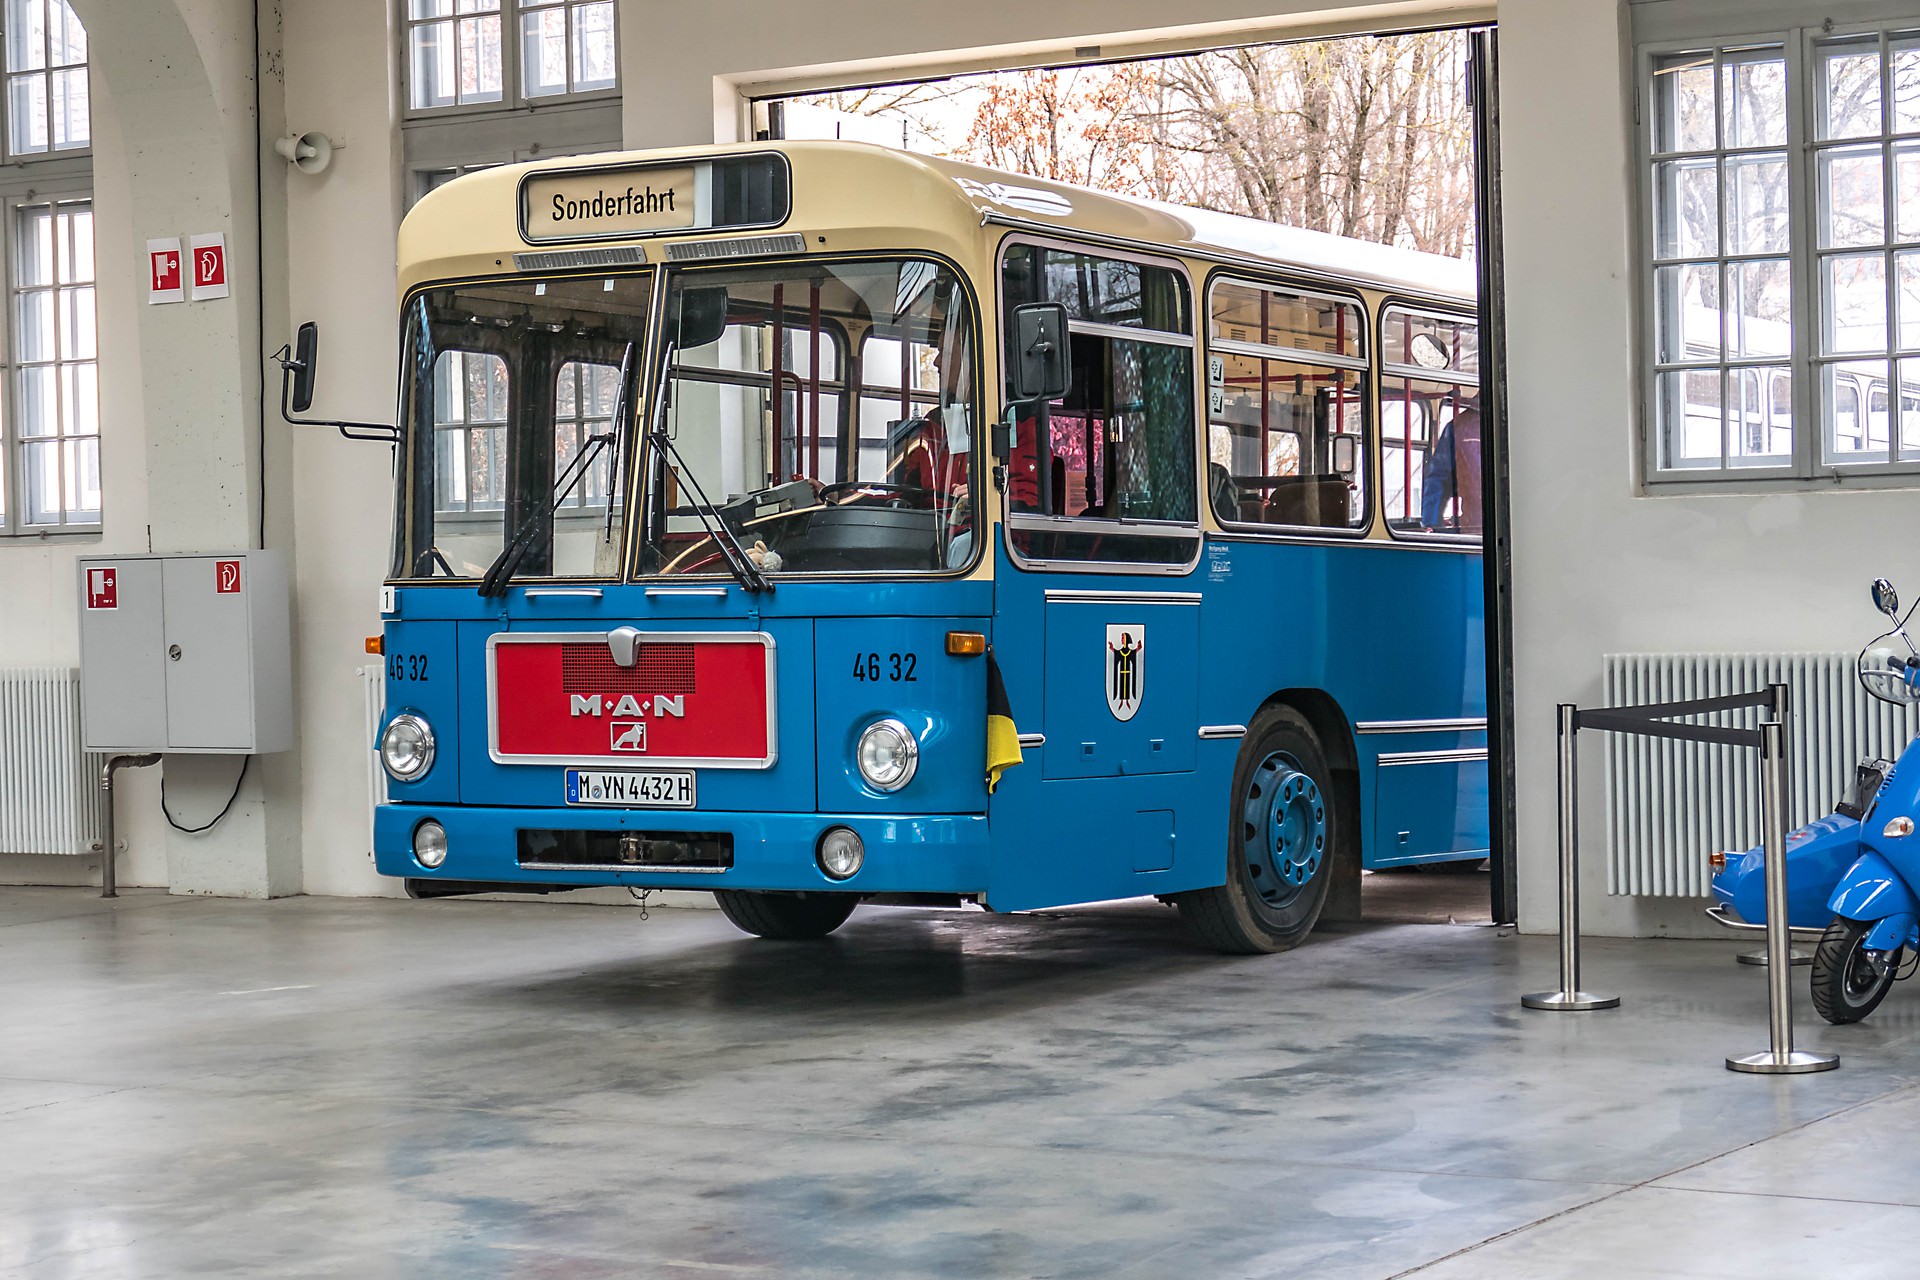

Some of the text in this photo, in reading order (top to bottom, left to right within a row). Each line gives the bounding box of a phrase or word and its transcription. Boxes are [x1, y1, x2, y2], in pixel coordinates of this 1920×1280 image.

[552, 186, 675, 221] Sonderfahrt
[384, 591, 389, 609] 1
[389, 654, 429, 682] 46 32
[853, 653, 917, 682] 46 32
